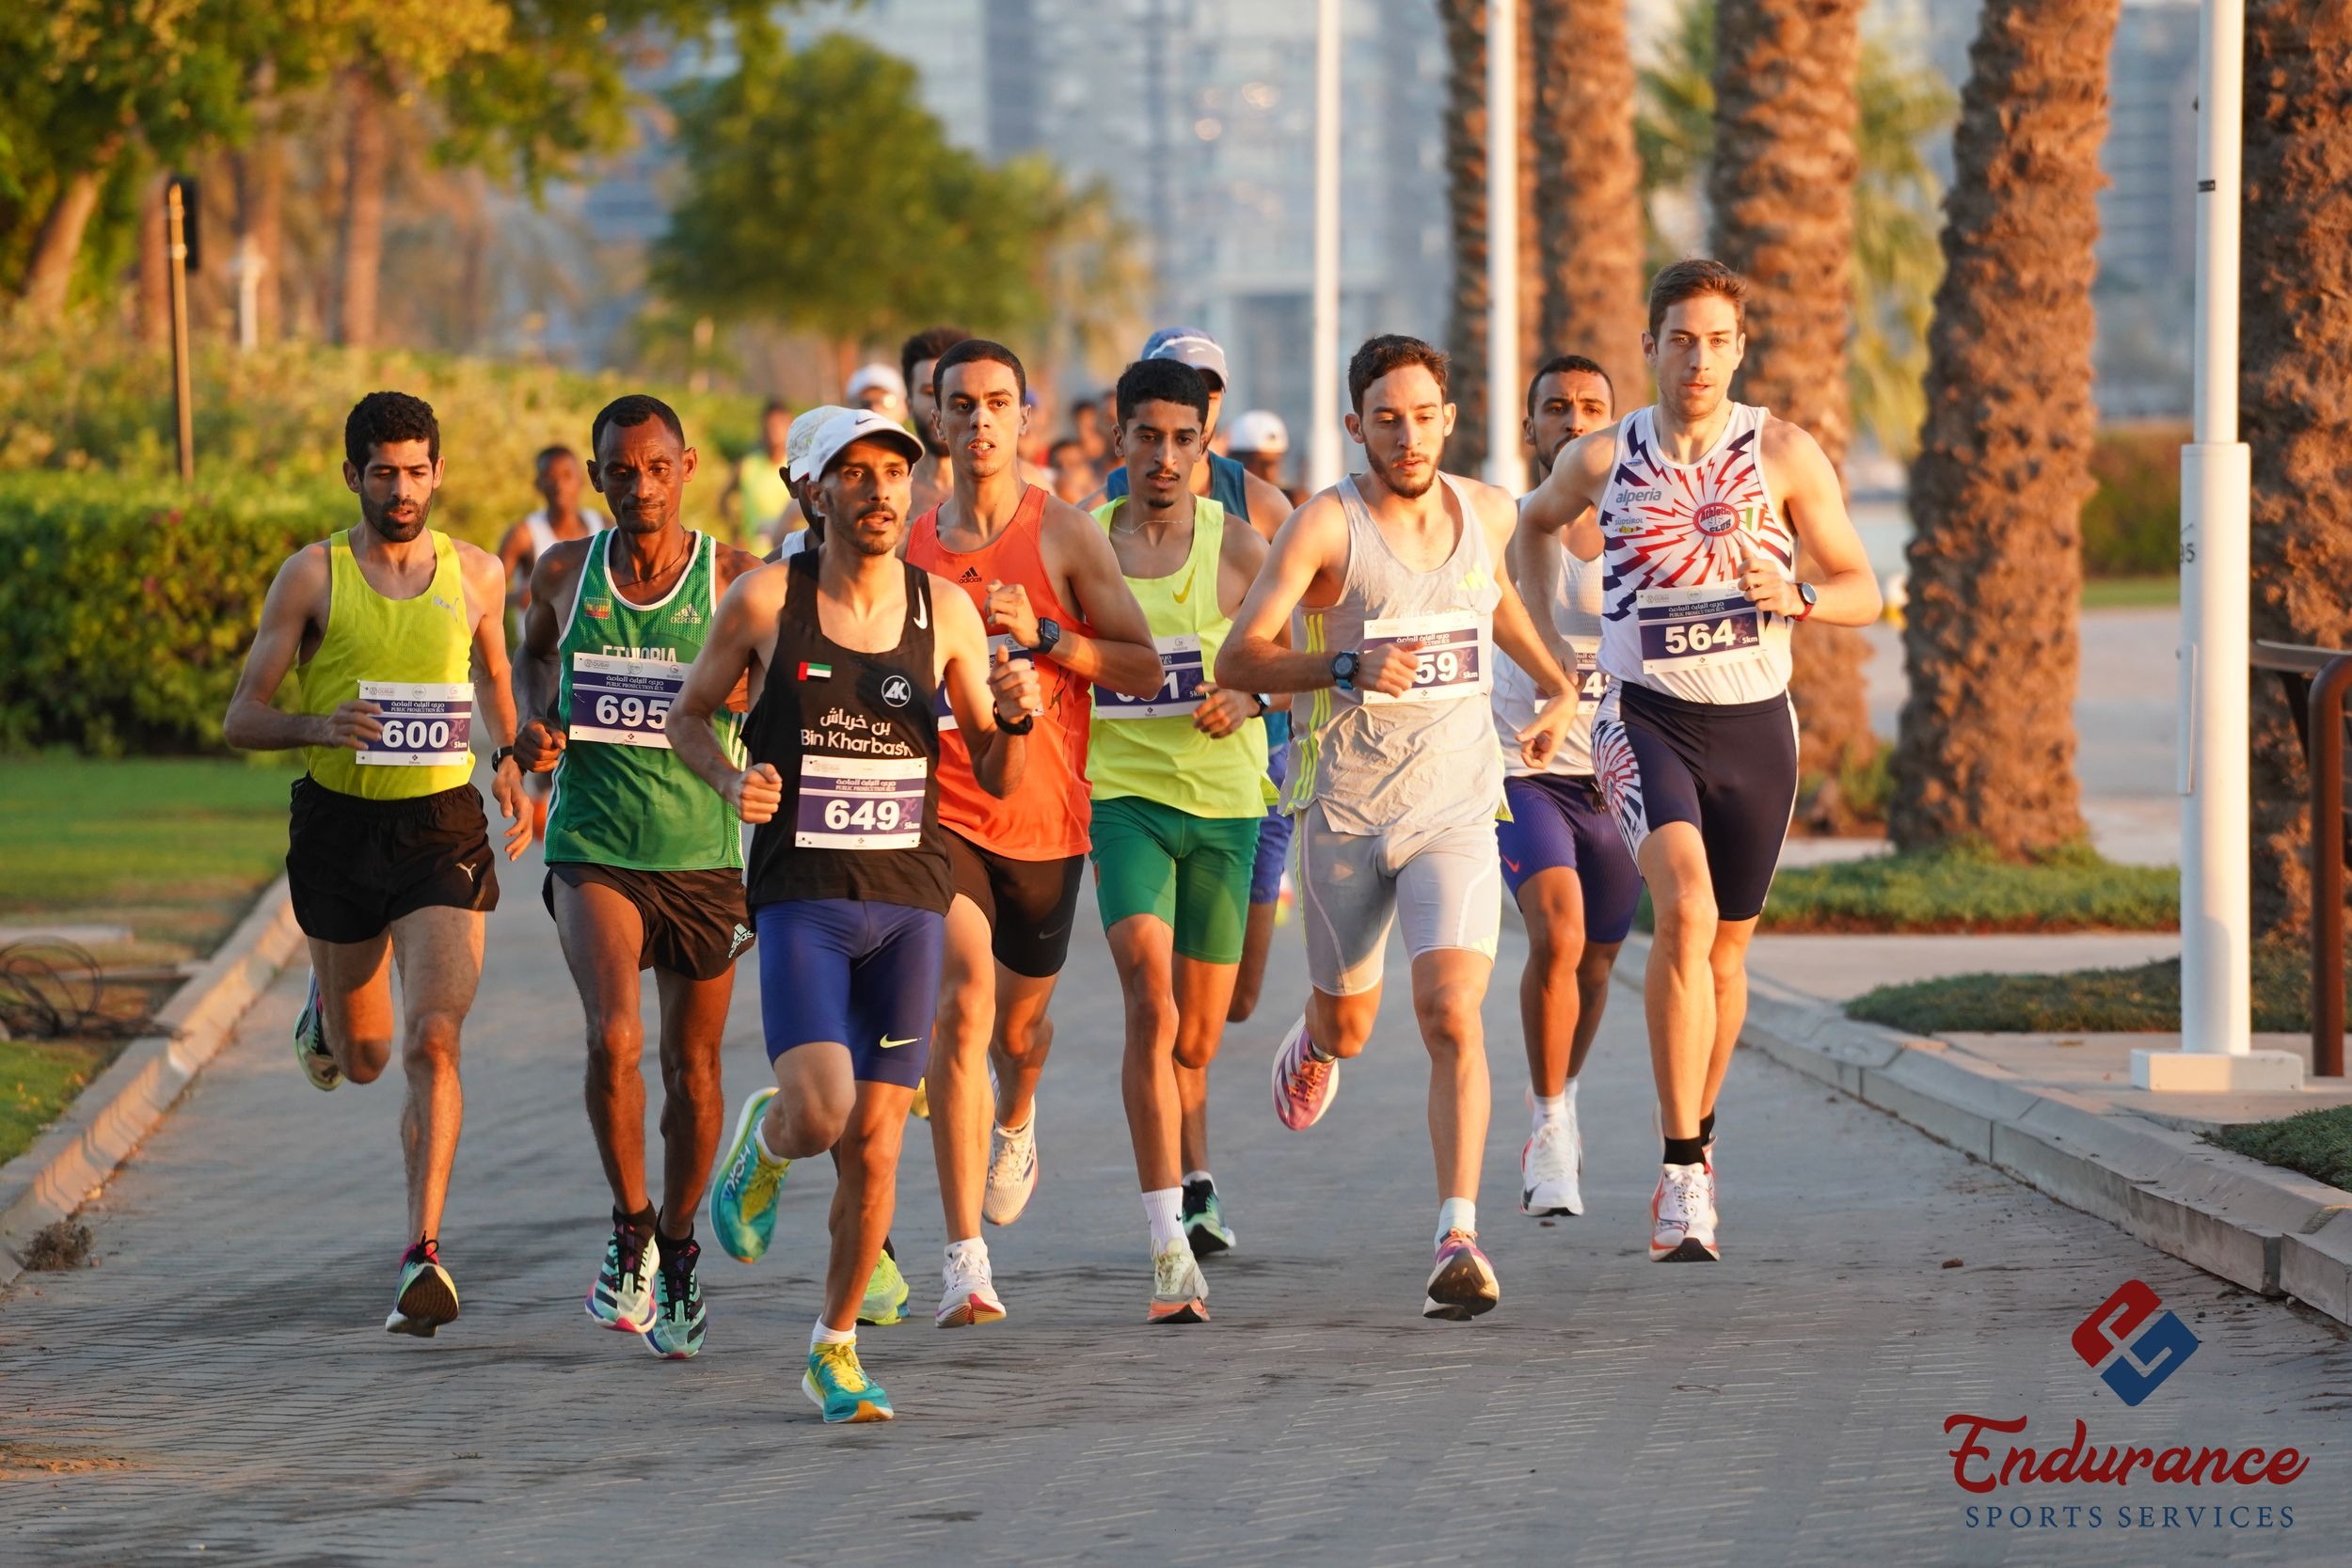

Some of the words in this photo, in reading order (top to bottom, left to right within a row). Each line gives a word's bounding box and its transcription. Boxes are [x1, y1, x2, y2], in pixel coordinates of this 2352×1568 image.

[1615, 487, 1662, 506] alperia
[1709, 519, 1731, 532] CLUB
[959, 576, 982, 584] adidas
[1664, 618, 1737, 654] 564
[1741, 635, 1758, 644] 5km
[1415, 652, 1459, 685] 59
[1463, 671, 1478, 679] 5km
[596, 694, 671, 730] 695
[819, 706, 868, 731] خرباش
[382, 720, 450, 749] 600
[871, 721, 891, 736] بن
[800, 728, 824, 747] Bin
[827, 730, 914, 757] Kharbash
[824, 799, 900, 832] 649
